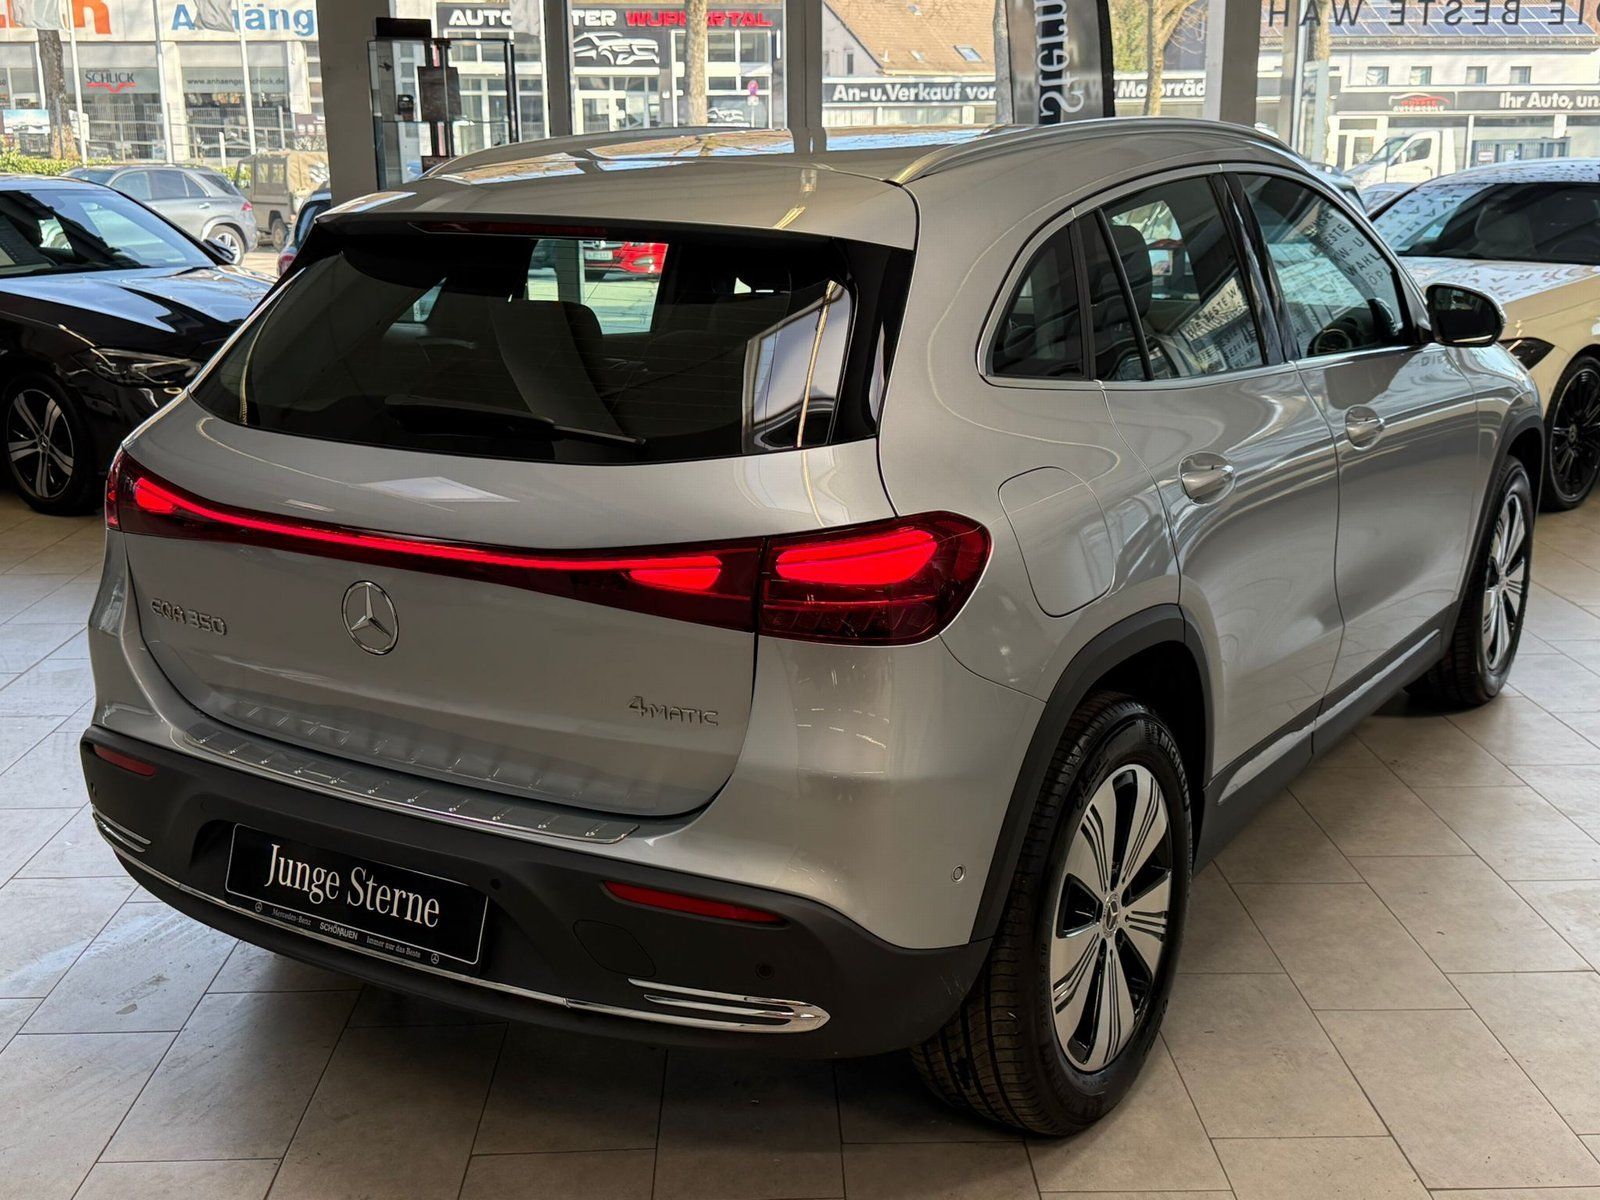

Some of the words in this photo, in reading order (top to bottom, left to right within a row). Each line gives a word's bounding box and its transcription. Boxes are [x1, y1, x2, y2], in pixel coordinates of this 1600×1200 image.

[172, 4, 315, 37] Aäng
[625, 10, 773, 27] WUPRTAL
[85, 72, 135, 83] SCHLICK
[1117, 79, 1206, 98] Morräd
[1499, 92, 1525, 108] Ihr
[1527, 92, 1573, 110] Auto,
[1575, 95, 1600, 108] un
[151, 597, 187, 625] EQA
[188, 608, 228, 636] 350
[628, 695, 719, 726] 4MATIC
[264, 843, 340, 905] Junge
[347, 866, 440, 928] Sterne
[272, 907, 312, 927] Mercedes-Benz
